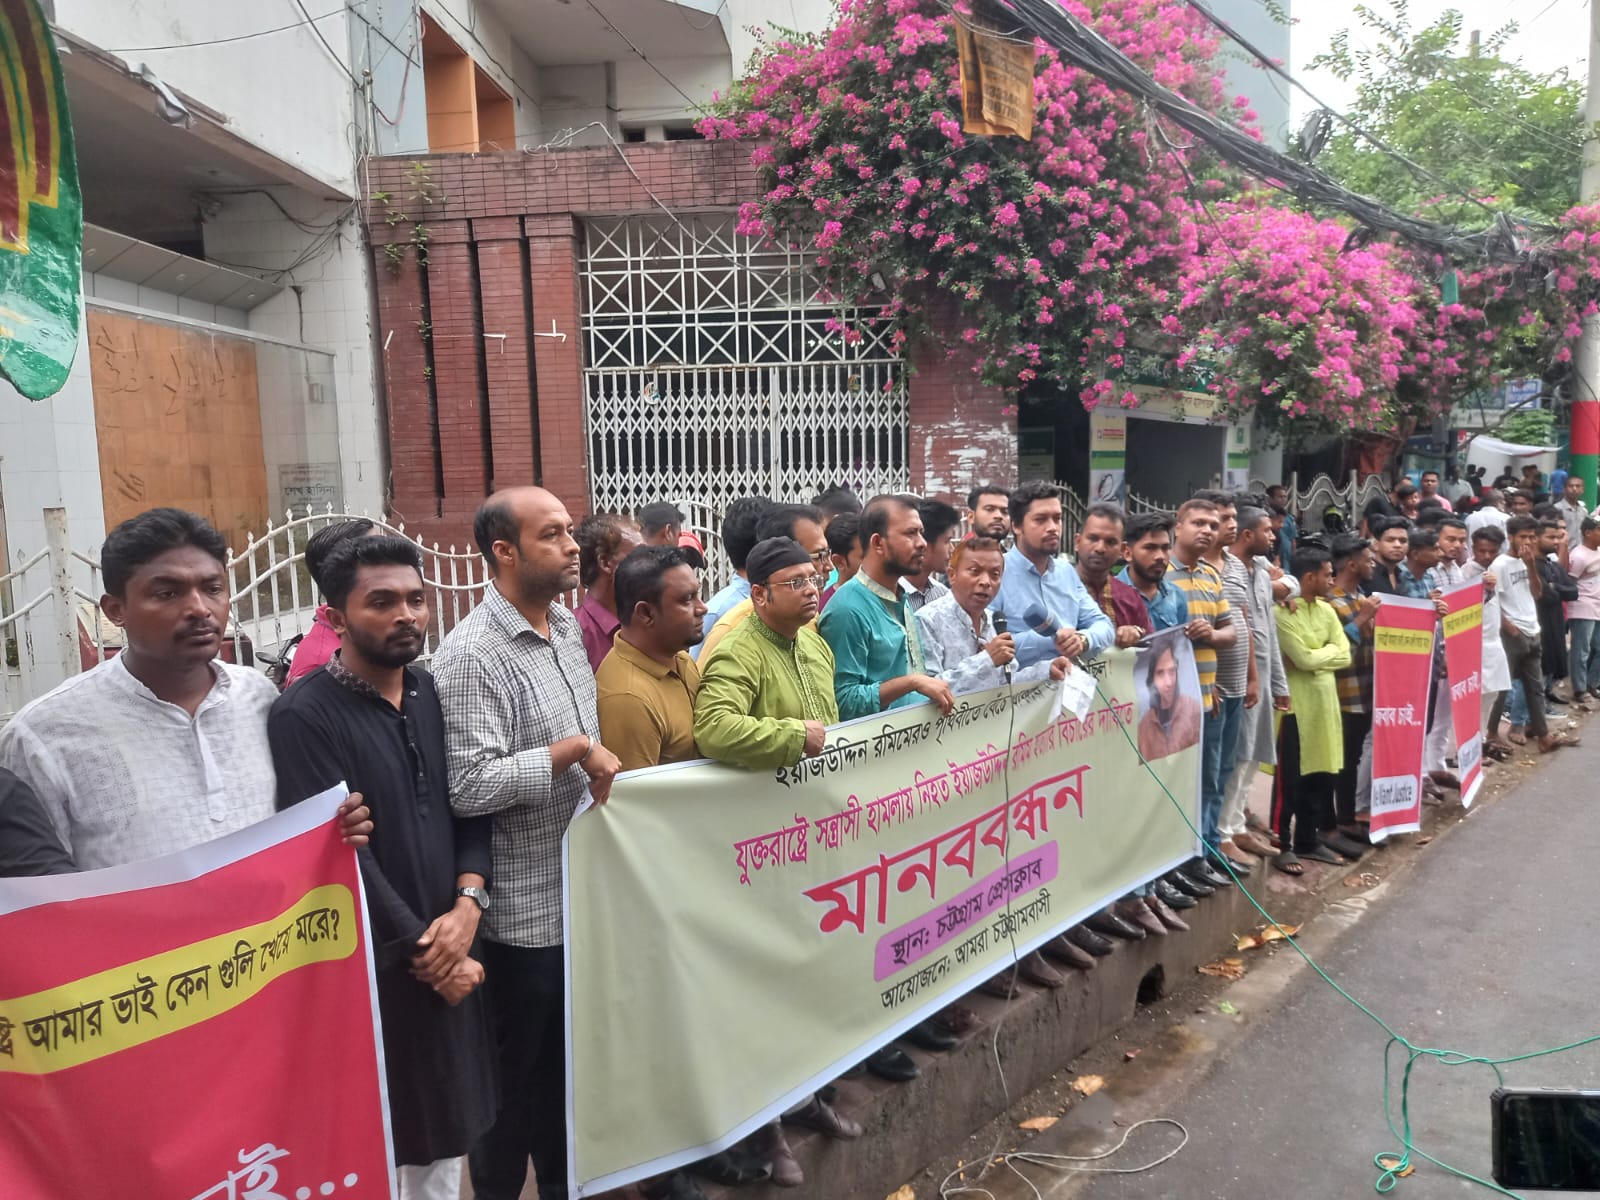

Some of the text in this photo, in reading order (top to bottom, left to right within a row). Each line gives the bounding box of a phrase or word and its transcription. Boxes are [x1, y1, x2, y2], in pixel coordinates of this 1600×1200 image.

[734, 812, 809, 886] যুক্তরাষ্ট্রে
[915, 770, 950, 814] নিহত
[802, 764, 1091, 934] মানববন্ধন
[23, 1000, 104, 1052] আমার
[109, 972, 158, 1024] ভাই
[166, 964, 212, 1011] কেন
[218, 939, 256, 989] গুলি
[296, 907, 340, 946] মরে?
[955, 927, 989, 964] আমরা
